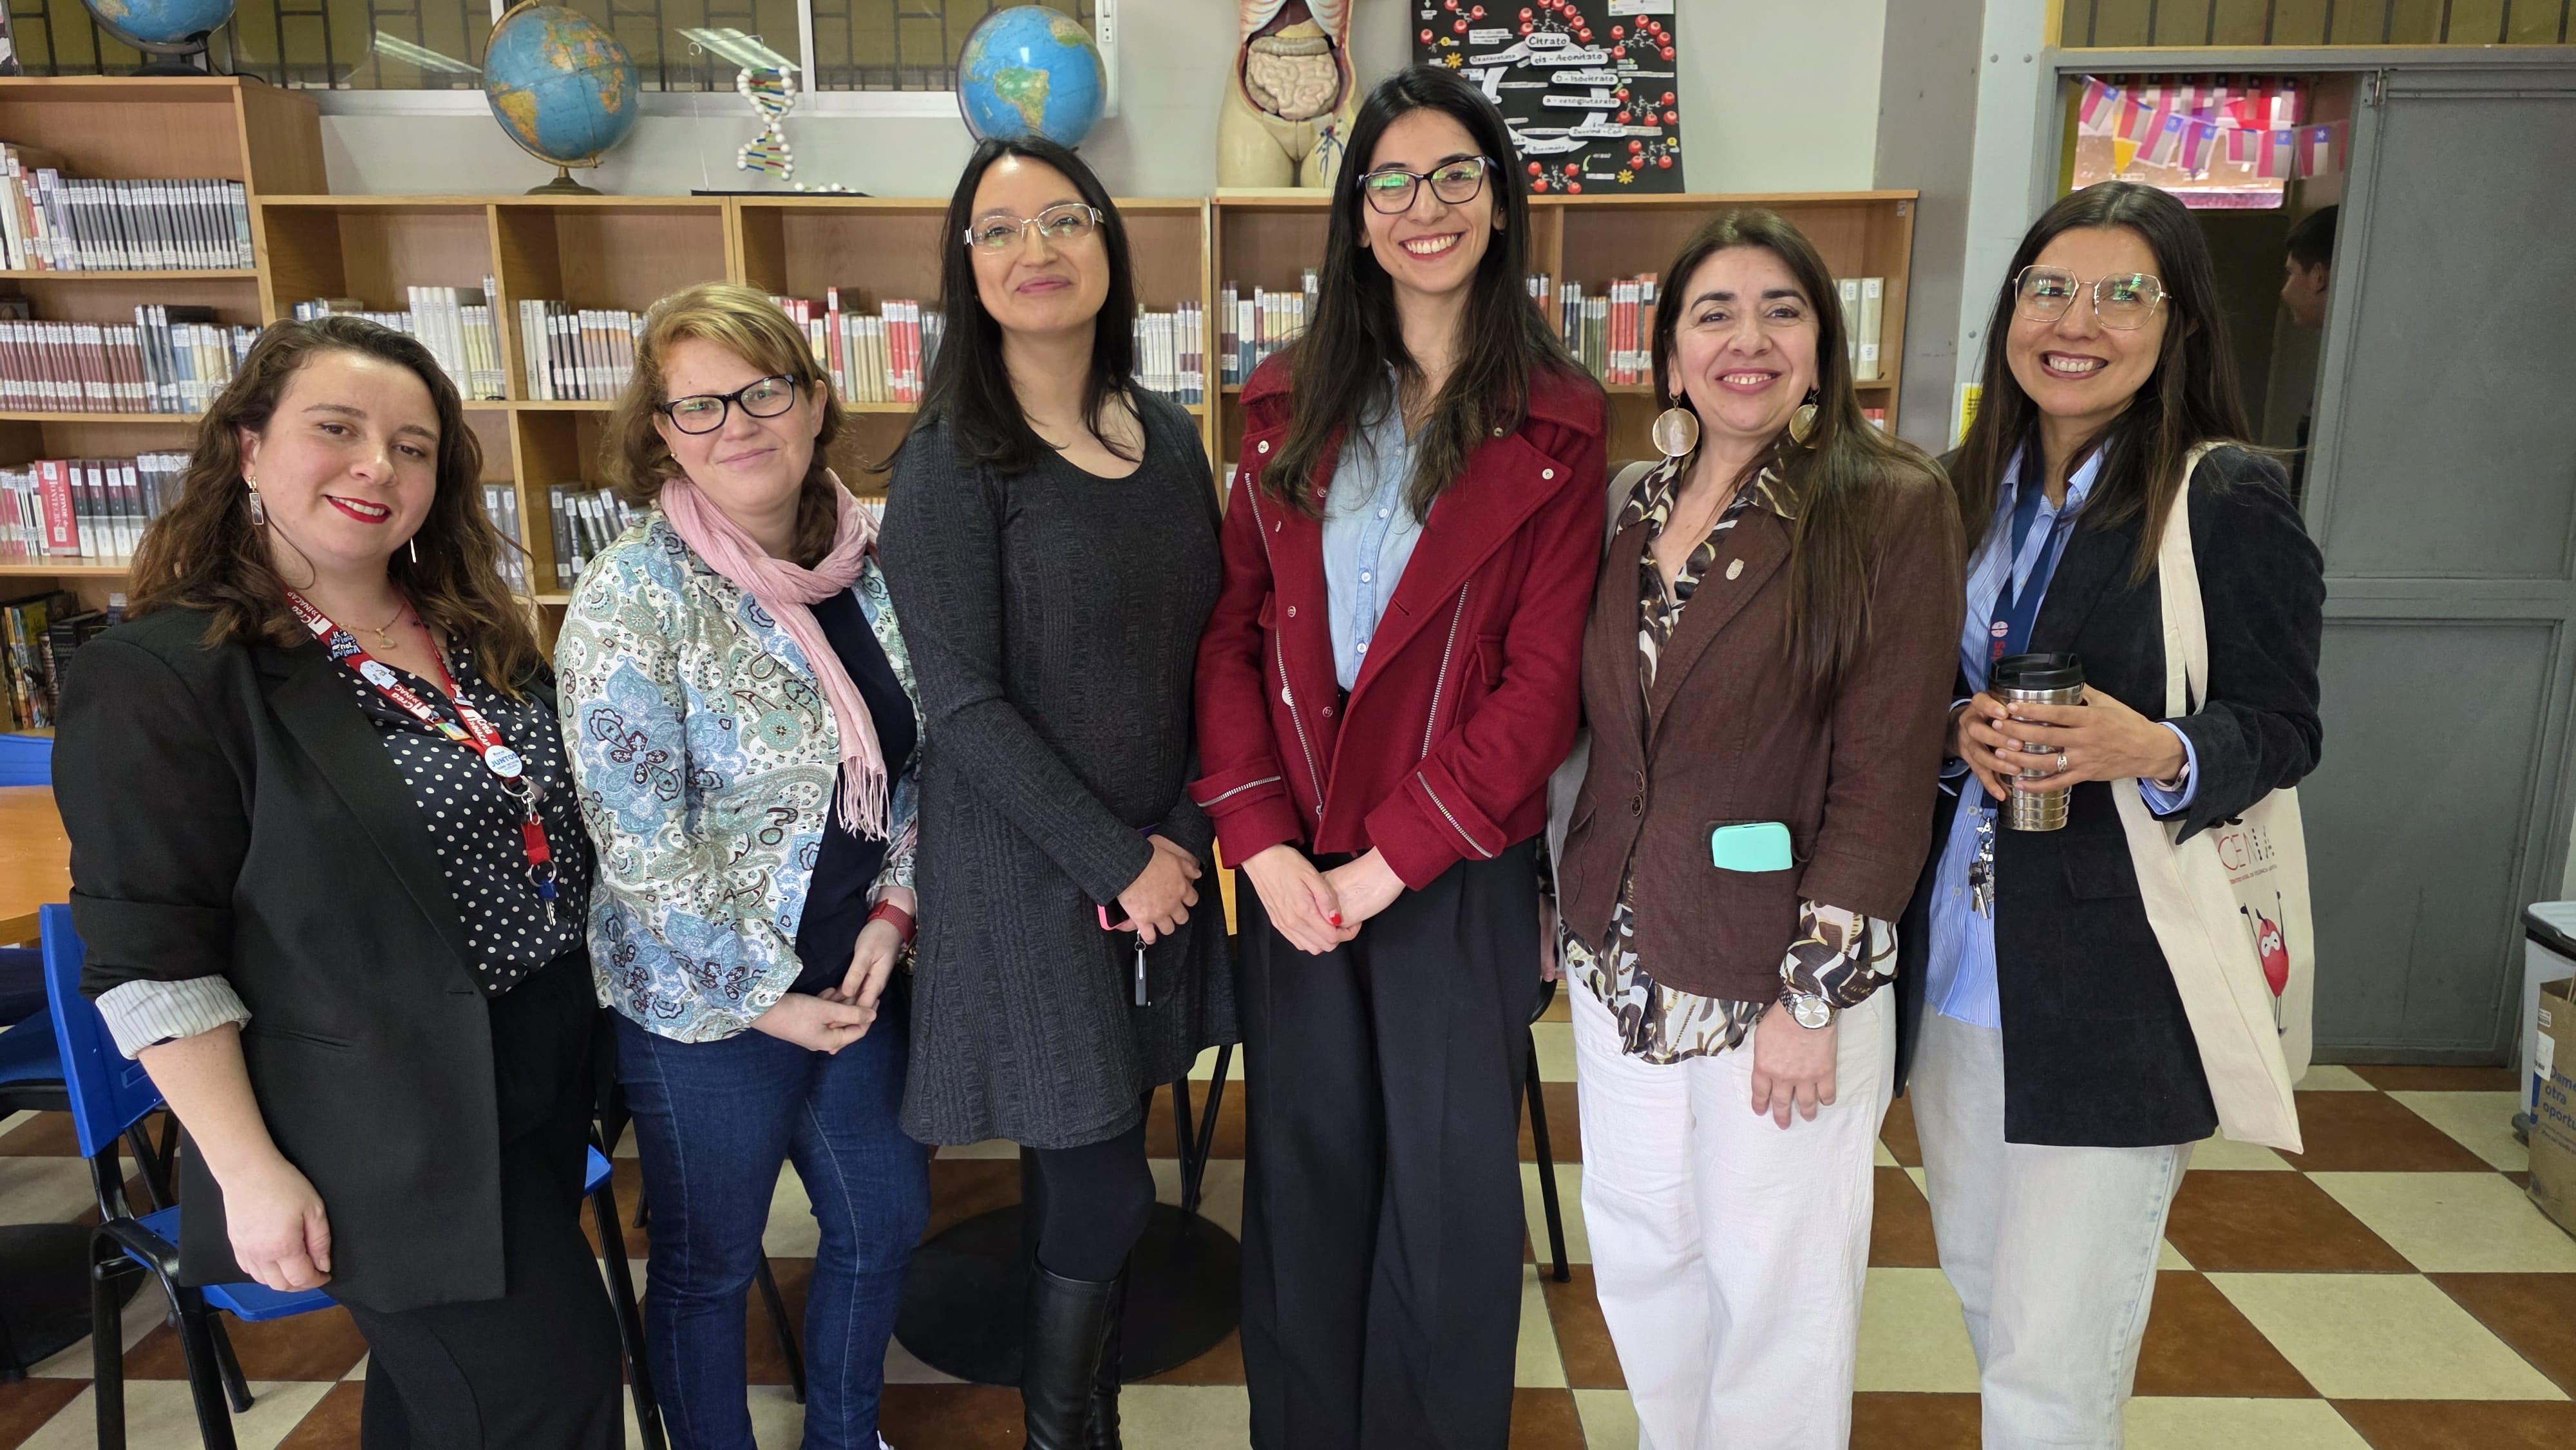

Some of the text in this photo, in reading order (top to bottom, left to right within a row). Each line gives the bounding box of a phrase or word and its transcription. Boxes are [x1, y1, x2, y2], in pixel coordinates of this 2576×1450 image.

[1529, 35, 1567, 45] Citrato
[1555, 53, 1603, 62] Aconitato
[291, 606, 312, 624] Crea
[391, 692, 413, 709] Crea
[477, 718, 494, 735] Crea
[491, 753, 518, 767] JUNTOS
[2544, 1083, 2567, 1106] otra
